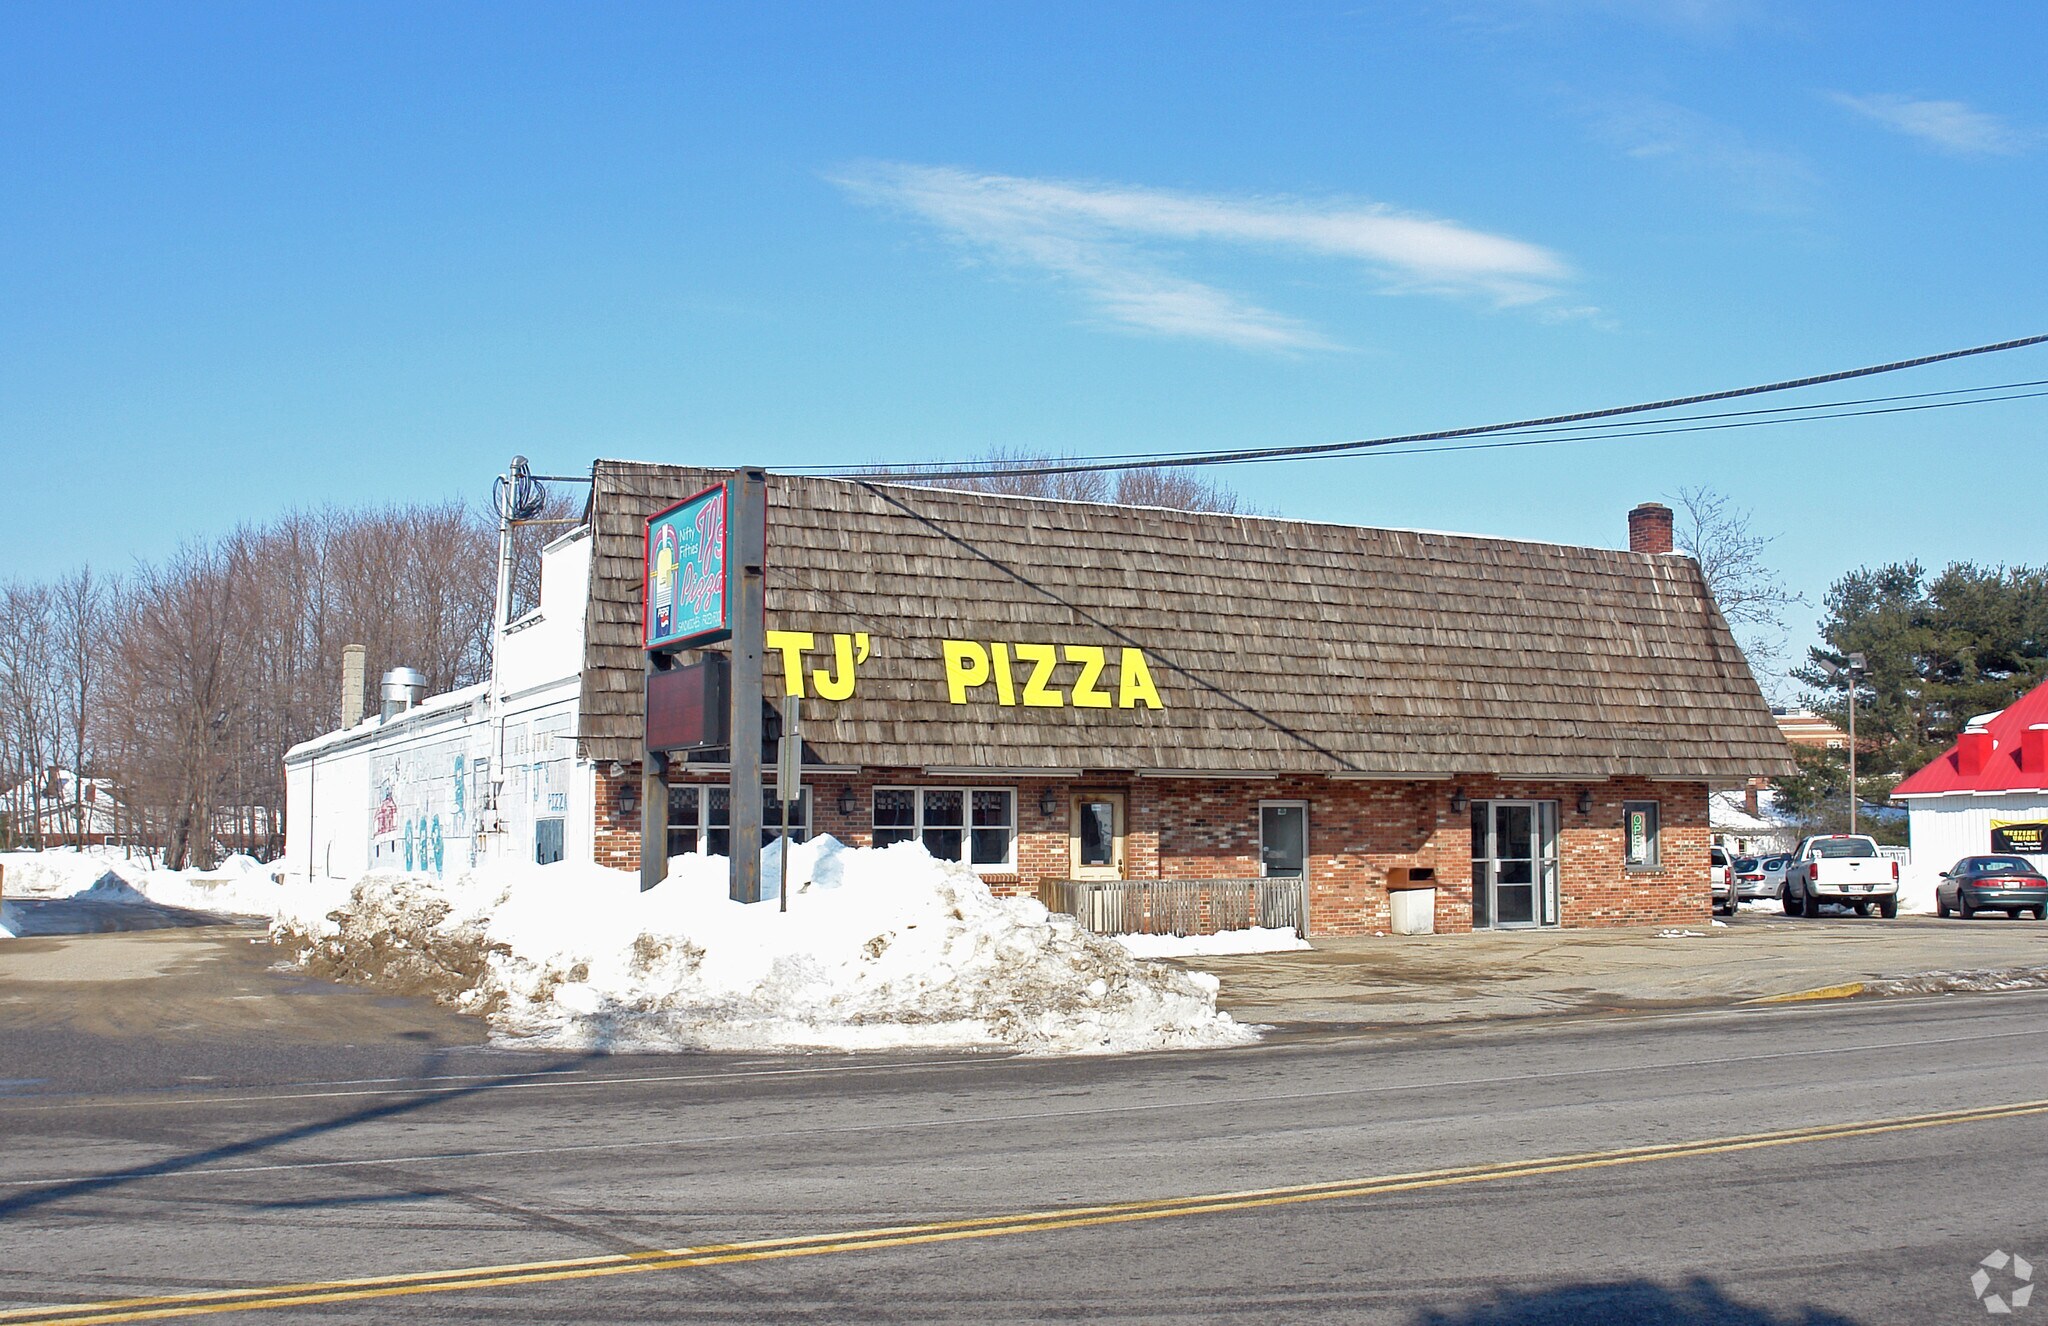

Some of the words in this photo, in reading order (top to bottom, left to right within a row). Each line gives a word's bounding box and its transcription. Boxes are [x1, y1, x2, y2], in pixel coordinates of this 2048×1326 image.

[680, 526, 695, 542] Nifty
[680, 562, 722, 615] Pizza
[766, 630, 870, 701] TJ'
[942, 640, 1164, 709] PIZZA
